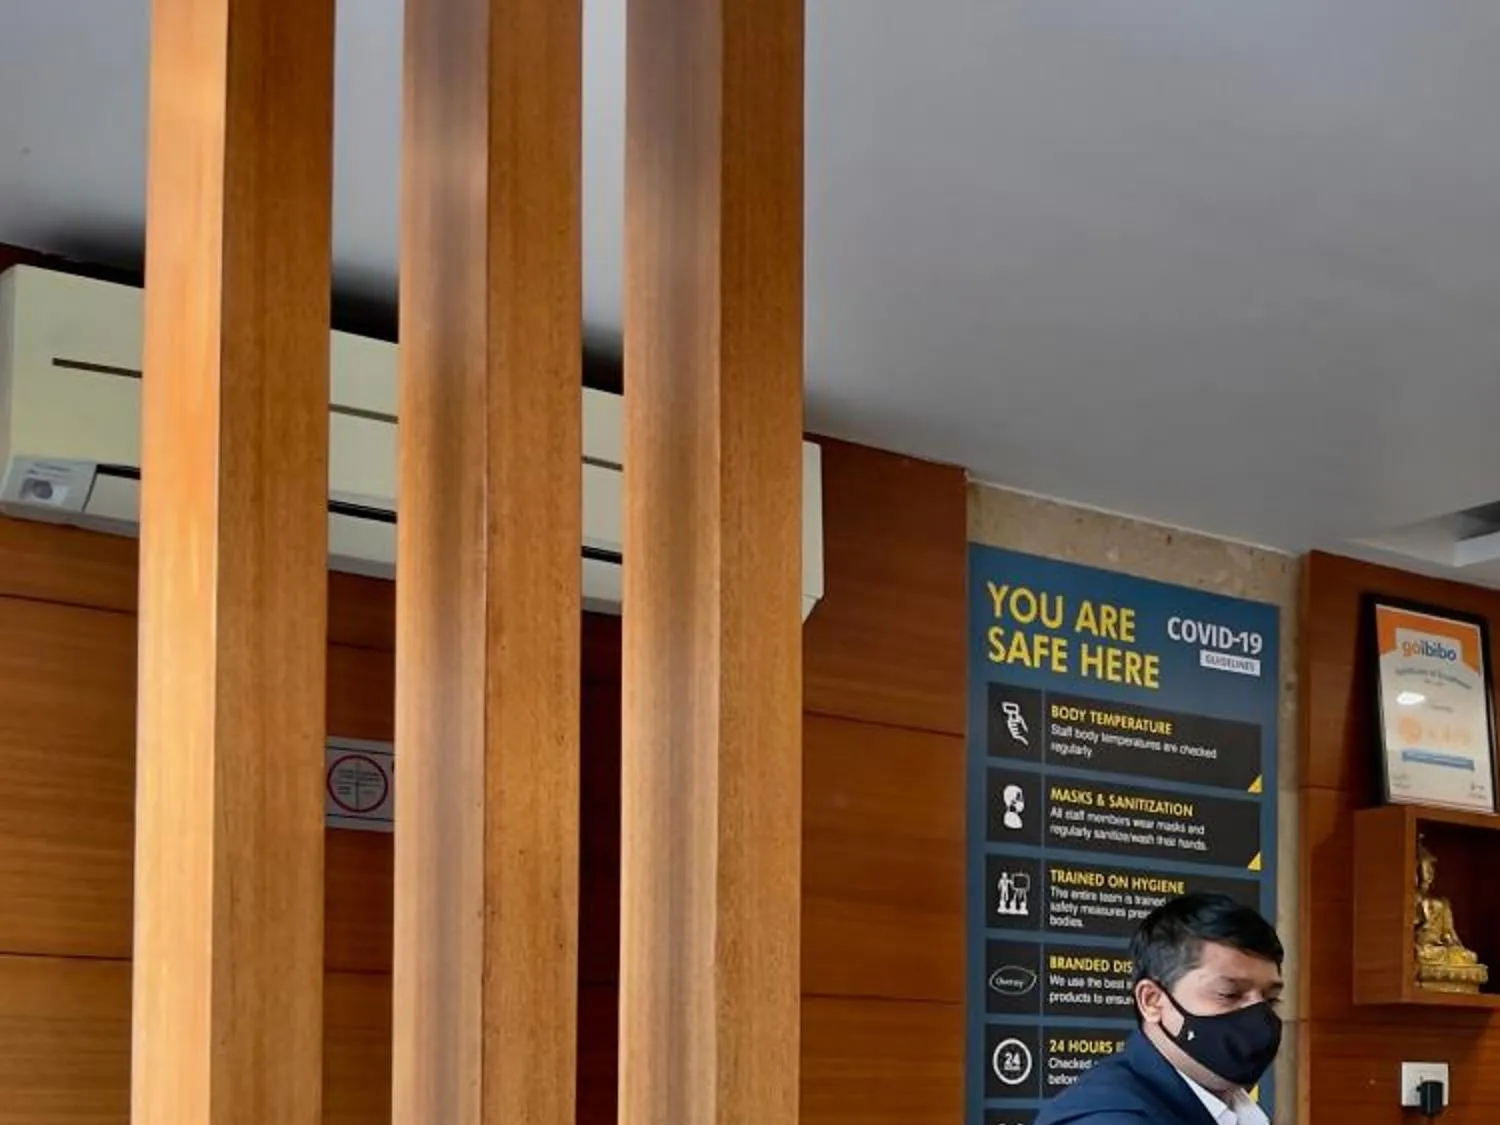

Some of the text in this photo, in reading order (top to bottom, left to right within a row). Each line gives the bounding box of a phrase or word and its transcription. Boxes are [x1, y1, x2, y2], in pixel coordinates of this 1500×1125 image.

[987, 581, 1136, 642] YOU ARE
[1167, 616, 1263, 654] COVID-19
[987, 626, 1160, 689] SAFE HERE
[1051, 704, 1173, 735] BODY TEMPERATURE
[1051, 723, 1073, 737] Staff
[1074, 728, 1098, 744] body
[1179, 744, 1217, 759] checked
[1050, 787, 1193, 817] MASKS & SANITIZATION
[1050, 805, 1205, 836] All staff members wear masks and
[1050, 825, 1092, 841] regularly
[1156, 833, 1177, 847] their
[1050, 869, 1185, 895] TRAINED ON HYGIENE
[1050, 886, 1068, 899] The
[1070, 889, 1097, 901] entire
[1050, 902, 1078, 917] safety
[1080, 904, 1126, 917] measures
[1049, 955, 1110, 972] BRANDED
[1050, 974, 1065, 986] We
[1067, 978, 1084, 988] use
[1087, 977, 1102, 989] the
[1104, 979, 1125, 990] best
[1049, 991, 1091, 1005] products
[1094, 993, 1103, 1004] to
[1049, 1039, 1065, 1053] 24
[1068, 1040, 1113, 1054] HOURS
[1048, 1057, 1092, 1070] Checked
